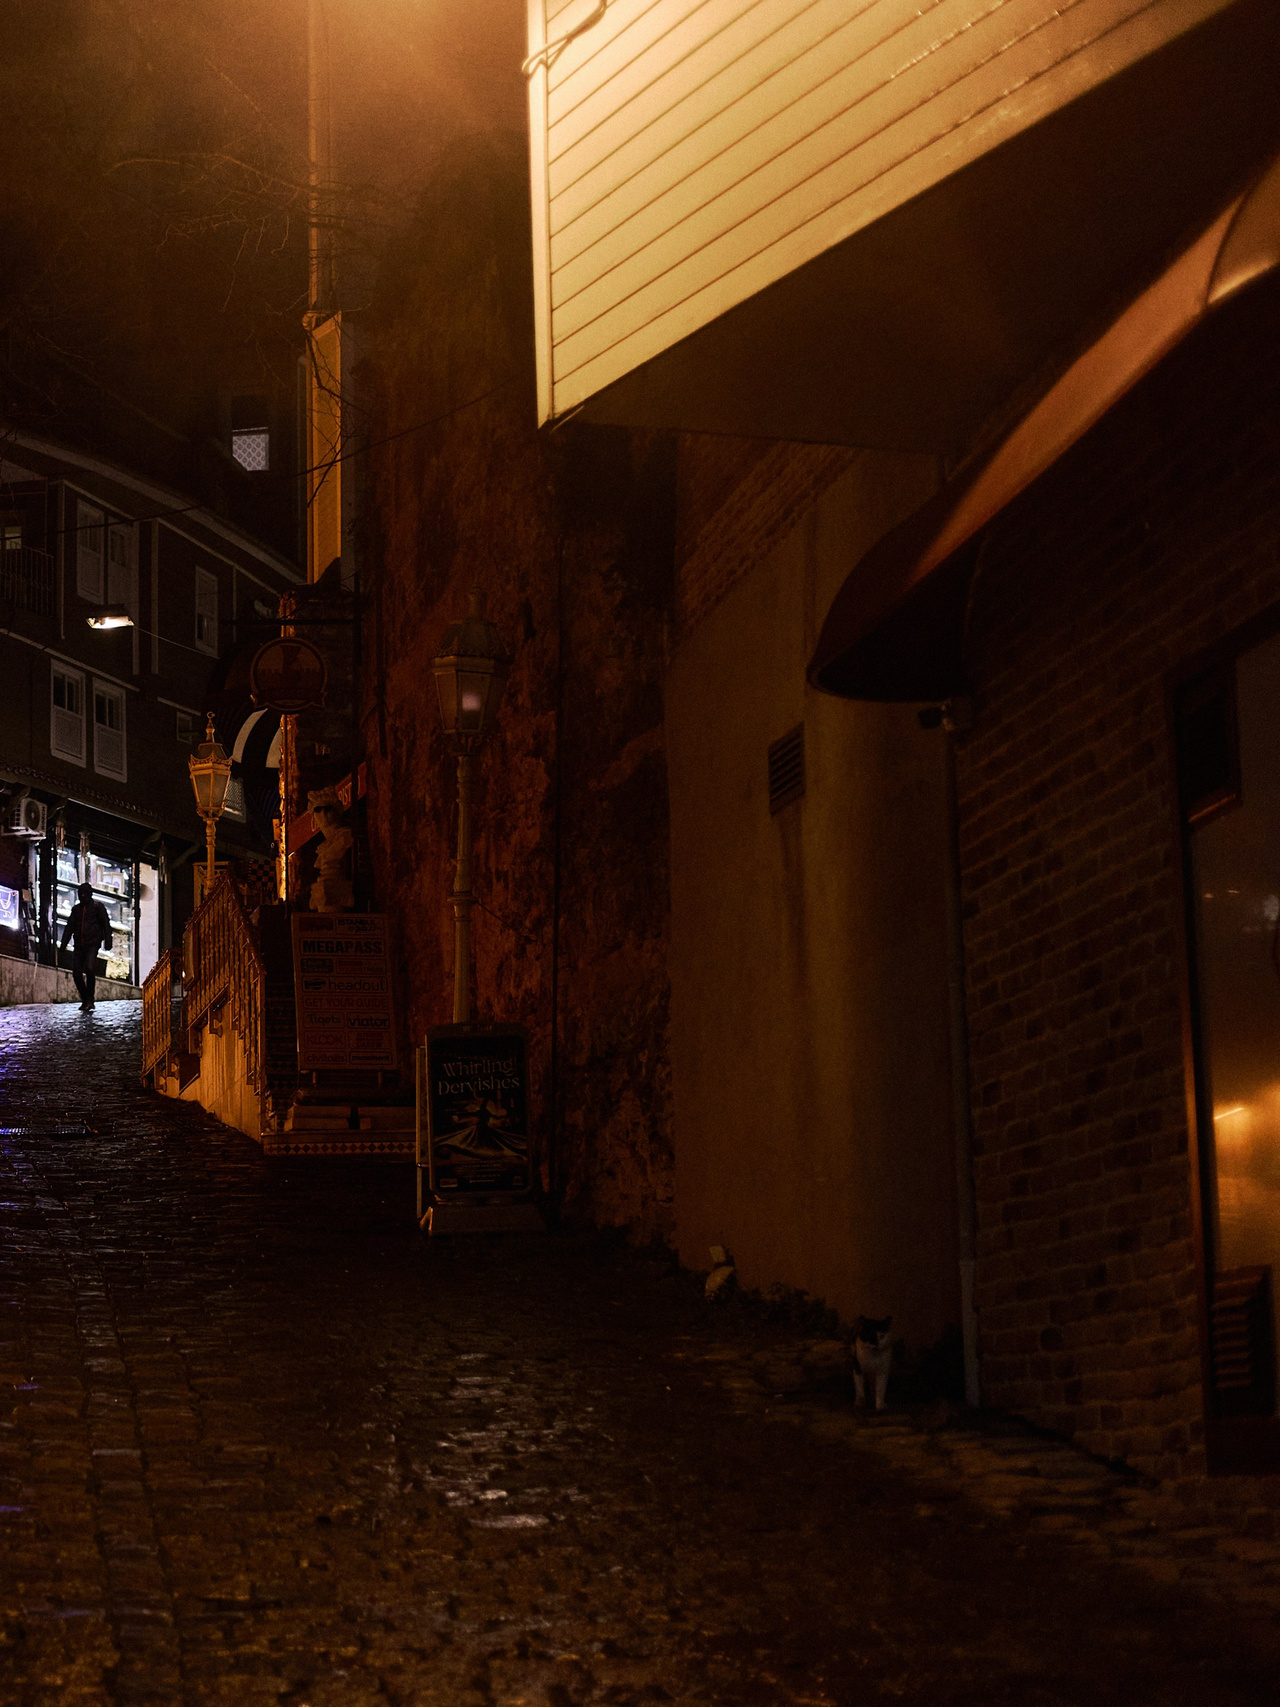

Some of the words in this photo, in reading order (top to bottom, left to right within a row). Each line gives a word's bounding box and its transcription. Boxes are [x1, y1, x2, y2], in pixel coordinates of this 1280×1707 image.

[303, 940, 382, 954] MEGAPASS
[328, 979, 386, 992] headout
[304, 997, 323, 1007] GET
[326, 997, 354, 1007] YOUR
[356, 997, 387, 1007] GUIDE
[348, 1015, 388, 1026] viator
[306, 1035, 344, 1045] KLOOK
[442, 1058, 515, 1077] Whirling
[438, 1072, 521, 1096] Dervishes
